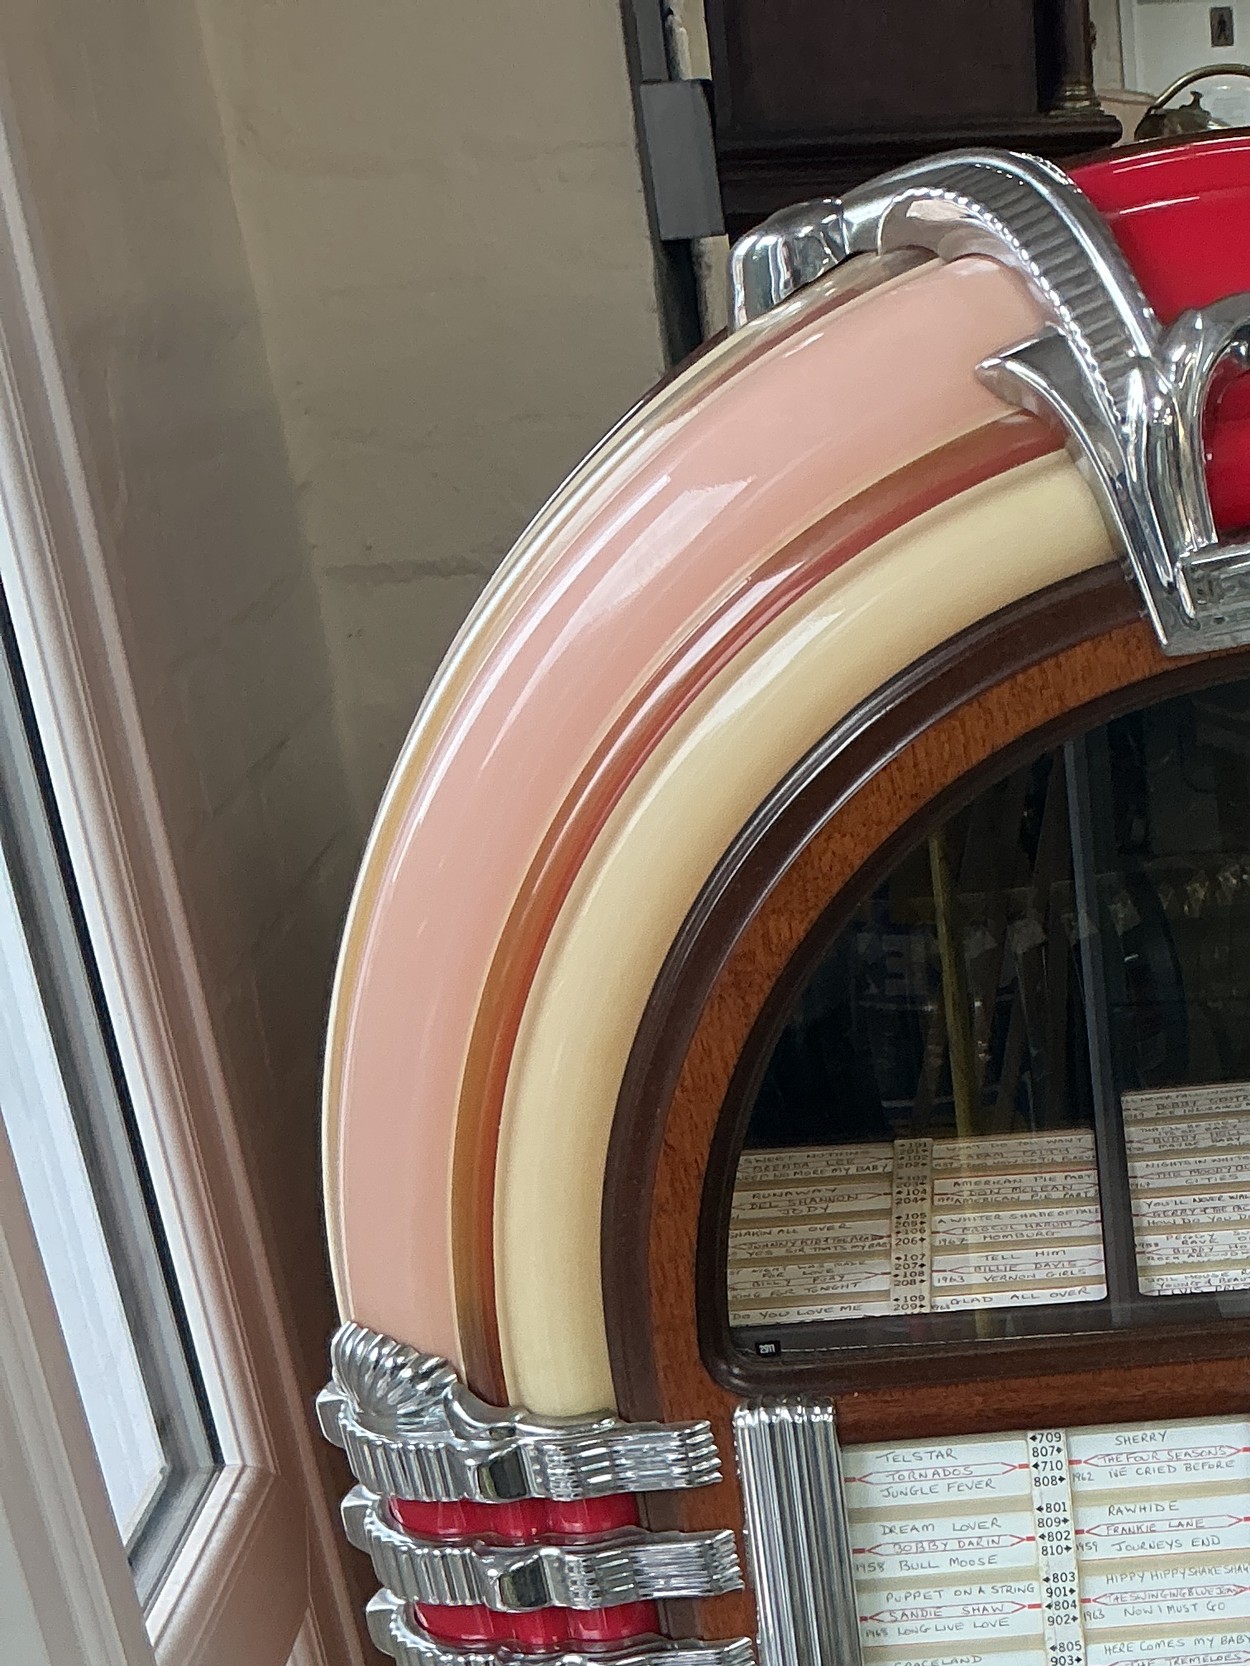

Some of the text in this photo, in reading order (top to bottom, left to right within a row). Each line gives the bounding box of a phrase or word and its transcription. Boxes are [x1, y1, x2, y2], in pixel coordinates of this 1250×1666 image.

[895, 1238, 918, 1246] 206
[903, 1254, 925, 1262] 107
[895, 1262, 919, 1270] 207
[950, 1296, 993, 1306] GLAD
[1050, 1287, 1090, 1298] OVER
[1038, 1432, 1062, 1443] 709
[1115, 1430, 1168, 1446] SHERRY
[876, 1448, 958, 1463] TELSTAR
[1032, 1447, 1055, 1457] 807
[1101, 1447, 1226, 1463] THE FOUR SEASONS
[1041, 1461, 1063, 1472] 710
[886, 1467, 974, 1482] TORNADOS
[1034, 1477, 1058, 1487] 808
[880, 1478, 996, 1498] JUNGLE FEVER
[1046, 1502, 1067, 1513] 801
[1109, 1500, 1179, 1516] RAWHIDE
[880, 1518, 1001, 1535] DREAM LOVER
[1038, 1517, 1061, 1528] 809
[1107, 1520, 1205, 1535] FRANKIE LANE
[1047, 1530, 1071, 1542] 802
[1111, 1535, 1221, 1552] JOURNEYS END
[1042, 1545, 1064, 1556] 810
[1052, 1572, 1075, 1583] 803
[1046, 1587, 1069, 1597] 901
[1054, 1601, 1077, 1611] 804
[1167, 1603, 1198, 1613] MUST
[1207, 1601, 1226, 1612] GO
[889, 1604, 1005, 1621] SANDIE SHAW
[1048, 1615, 1072, 1626] 902
[1059, 1641, 1082, 1650] 805
[1104, 1643, 1133, 1654] HERE
[1051, 1654, 1074, 1665] 903
